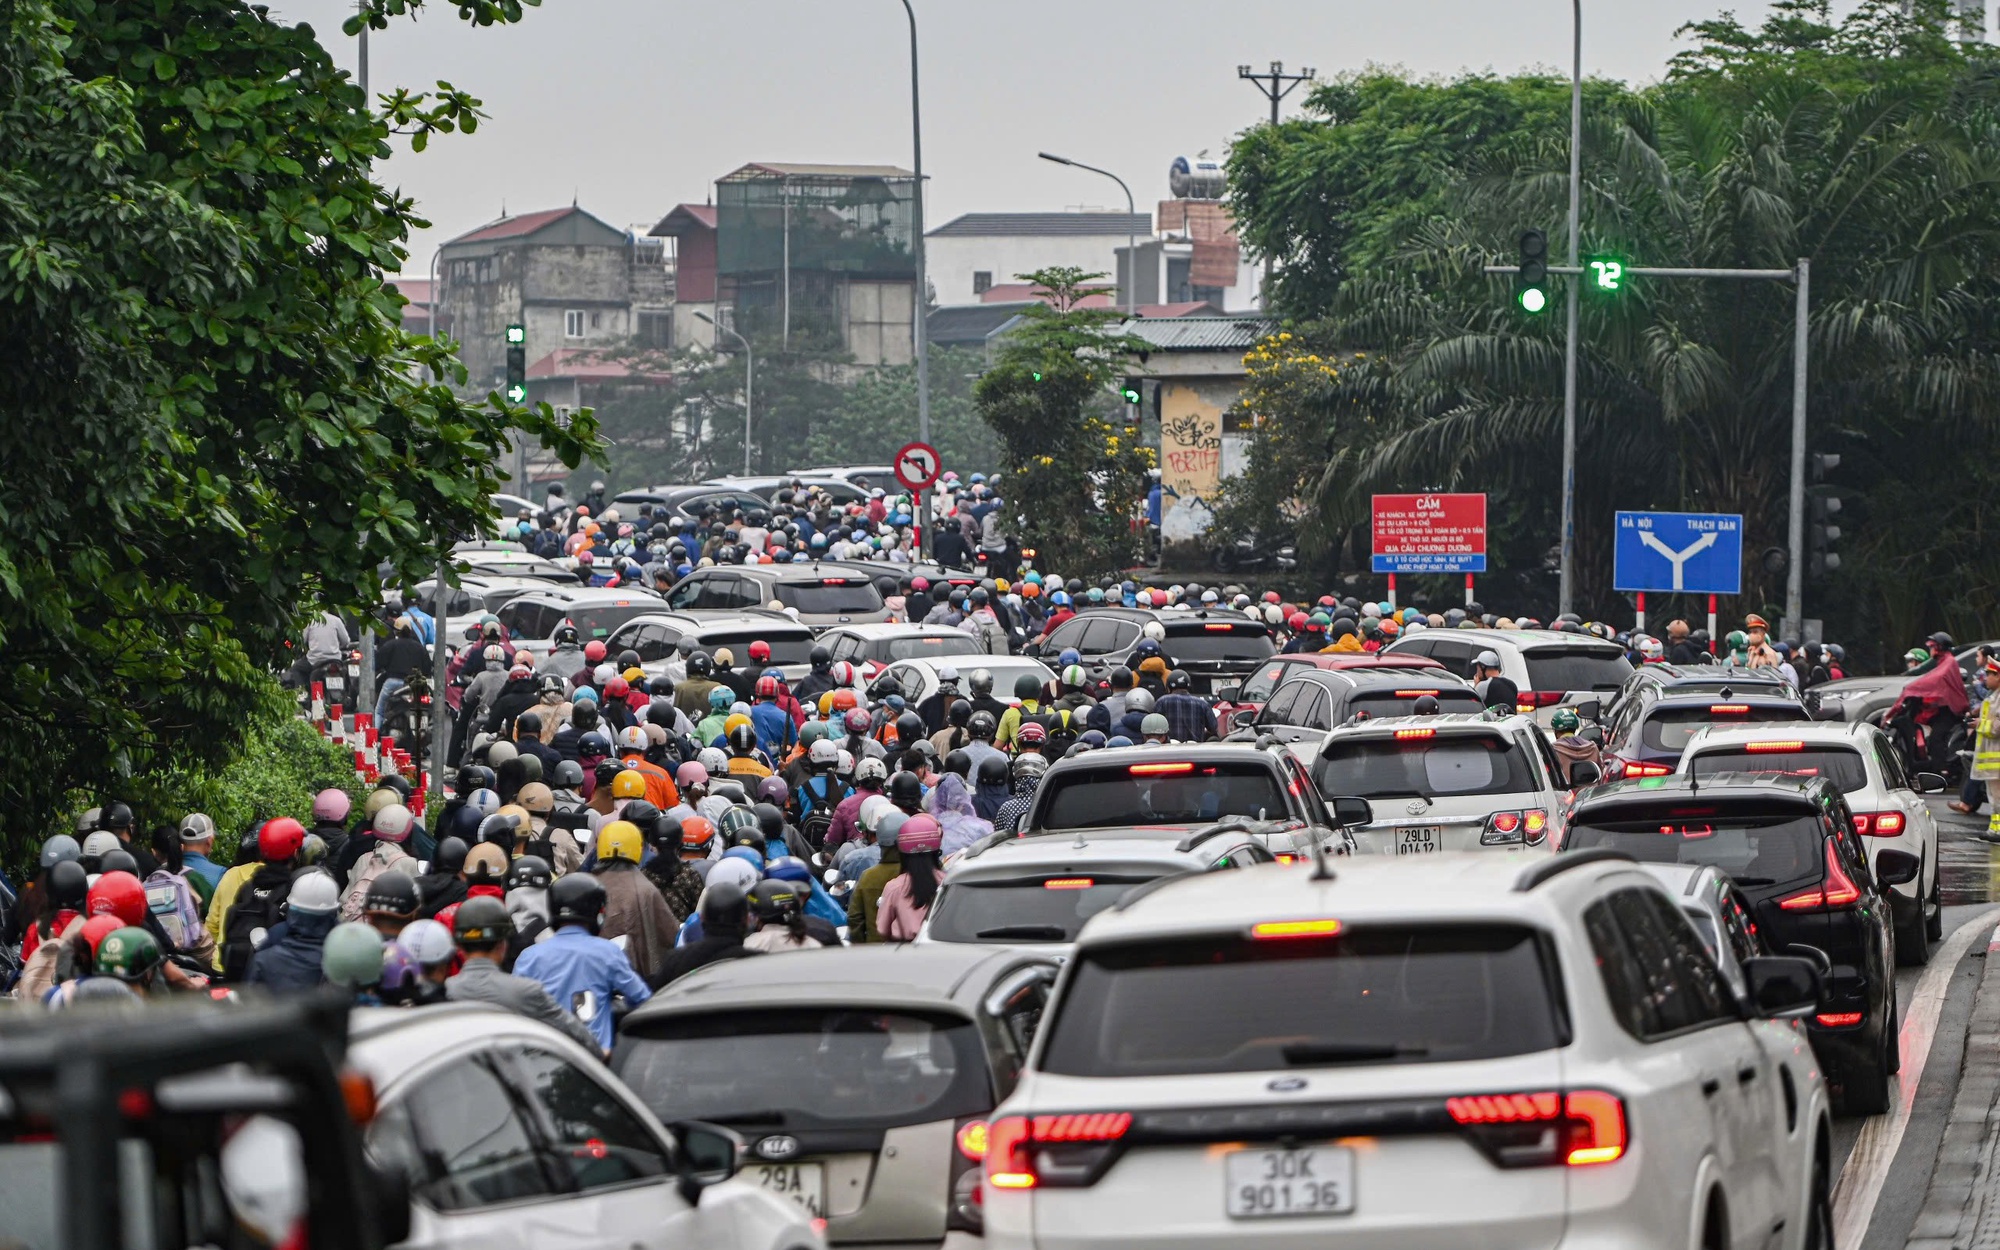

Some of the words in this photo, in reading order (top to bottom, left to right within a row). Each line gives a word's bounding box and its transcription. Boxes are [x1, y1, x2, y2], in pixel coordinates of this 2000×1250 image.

[1590, 261, 1621, 289] 72
[1416, 495, 1440, 509] CẤM
[1622, 515, 1634, 528] HÀ
[1638, 516, 1652, 529] NỘI
[1687, 519, 1715, 531] THẠCH
[1718, 518, 1736, 530] BÀN
[1404, 828, 1430, 843] 29LD
[763, 1140, 792, 1152] KIA
[1264, 1152, 1314, 1180] 30K
